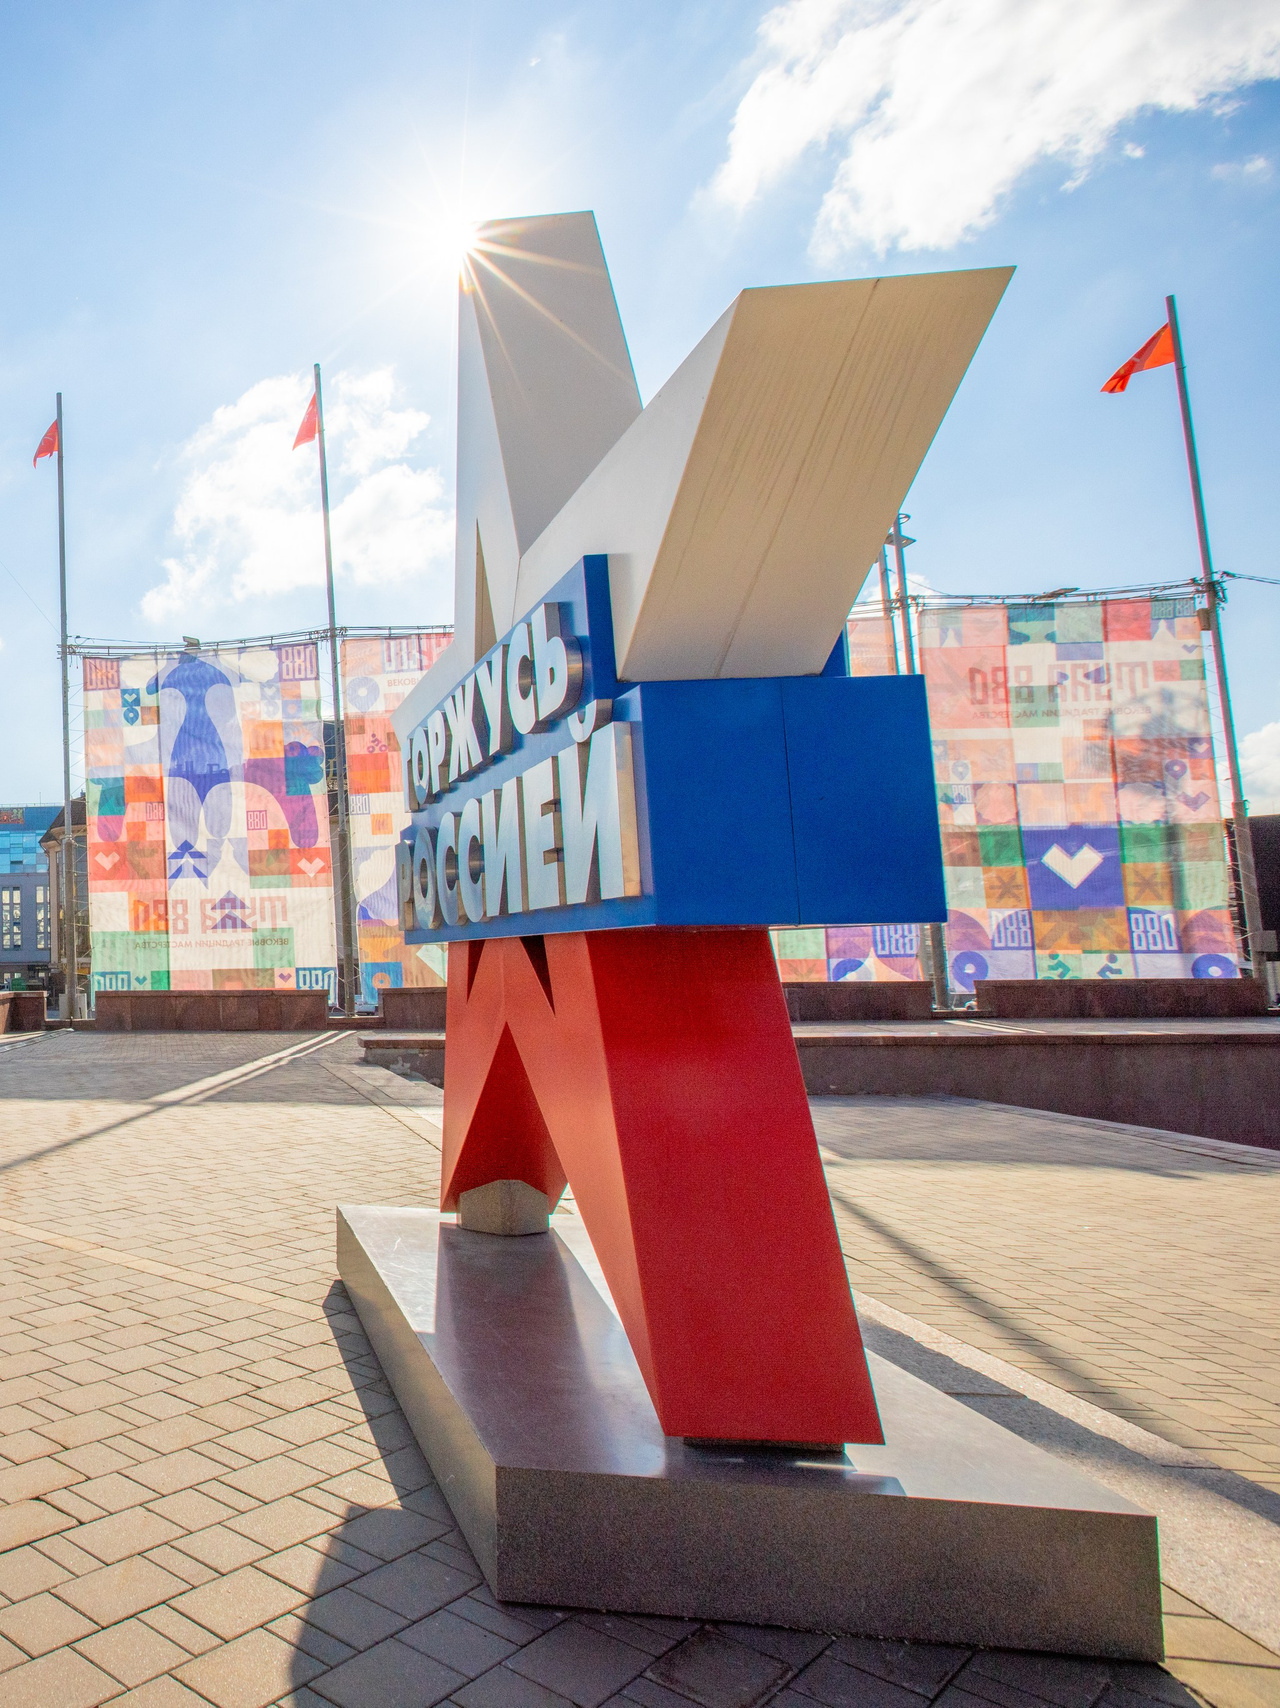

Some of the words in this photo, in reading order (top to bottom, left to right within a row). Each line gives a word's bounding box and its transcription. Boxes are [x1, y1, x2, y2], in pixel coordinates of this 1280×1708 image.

[282, 645, 317, 679] 880
[387, 678, 419, 687] ВЕКОВ
[404, 602, 574, 812] ГОРЖУСЬ
[248, 811, 267, 829] 880
[395, 699, 640, 931] РОССИЕЙ
[1130, 913, 1179, 951] 880
